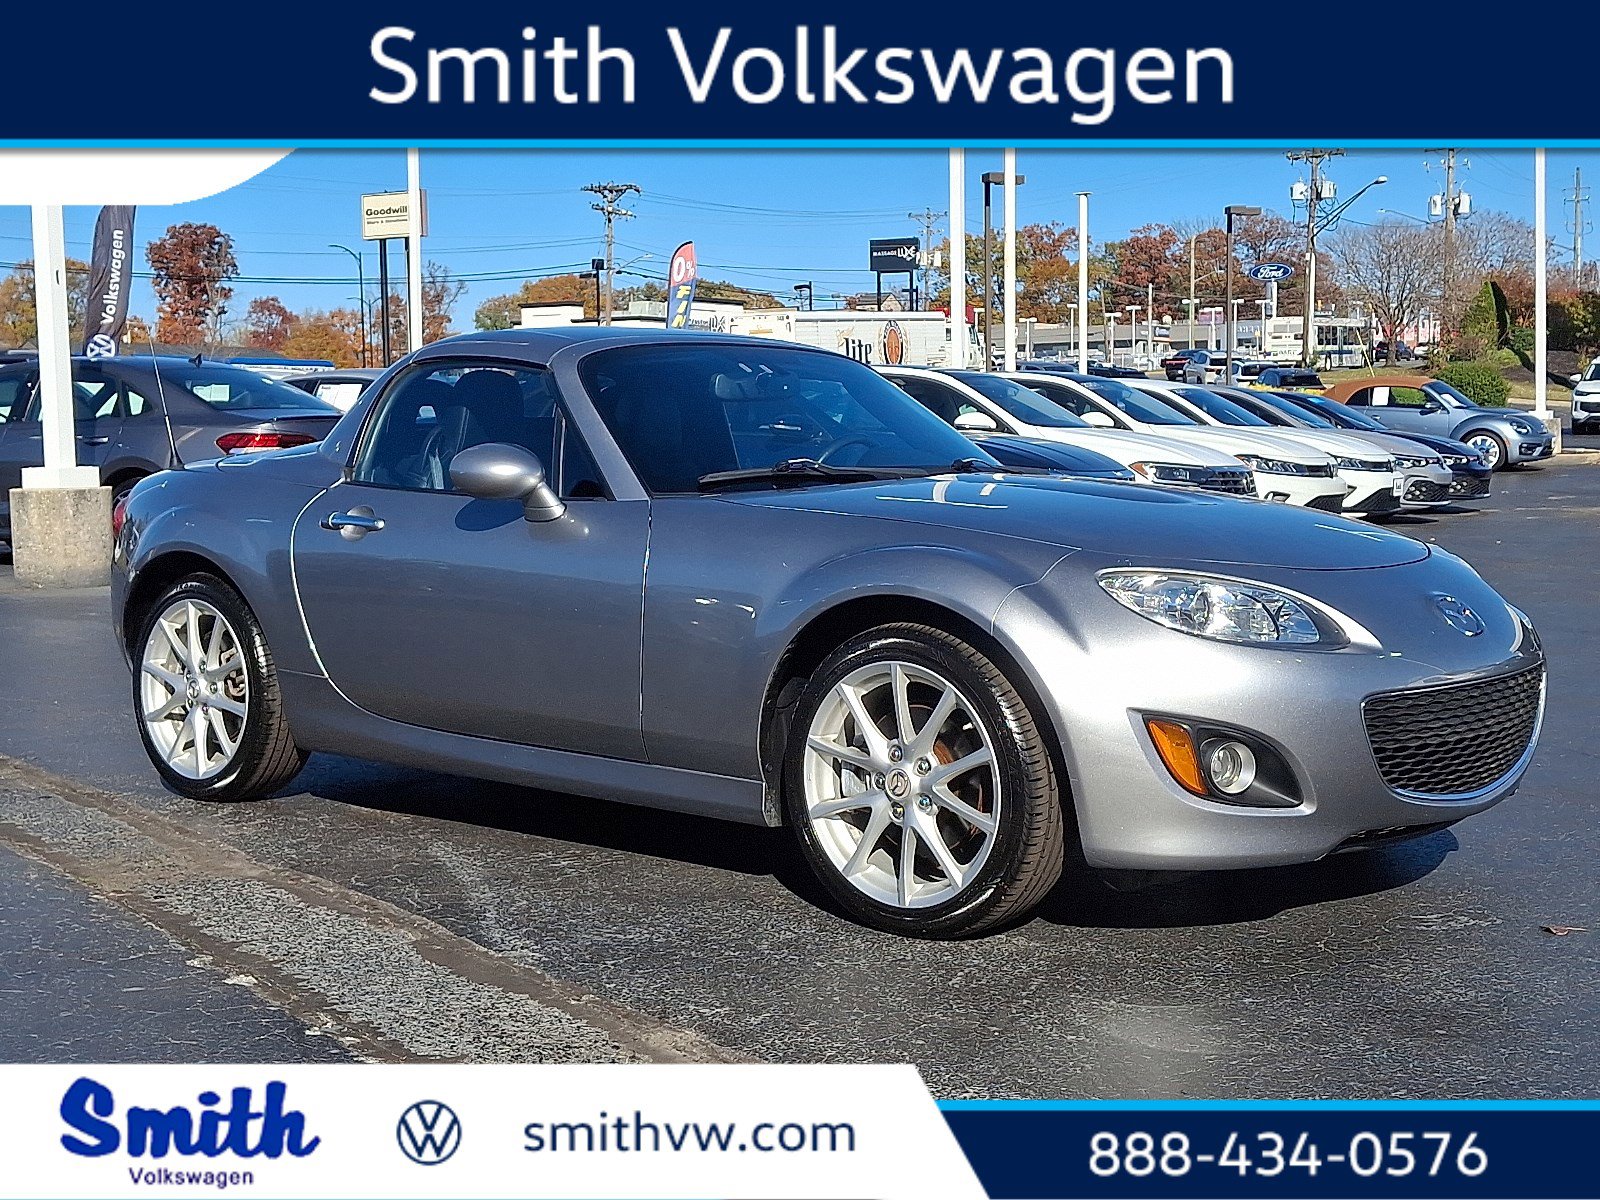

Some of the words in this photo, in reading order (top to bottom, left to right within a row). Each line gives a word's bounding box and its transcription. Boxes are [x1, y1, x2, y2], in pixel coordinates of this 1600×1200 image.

[366, 206, 408, 216] Goodwill
[101, 229, 125, 325] Volkswagen
[673, 256, 695, 283] 0%
[1258, 265, 1285, 278] Ford
